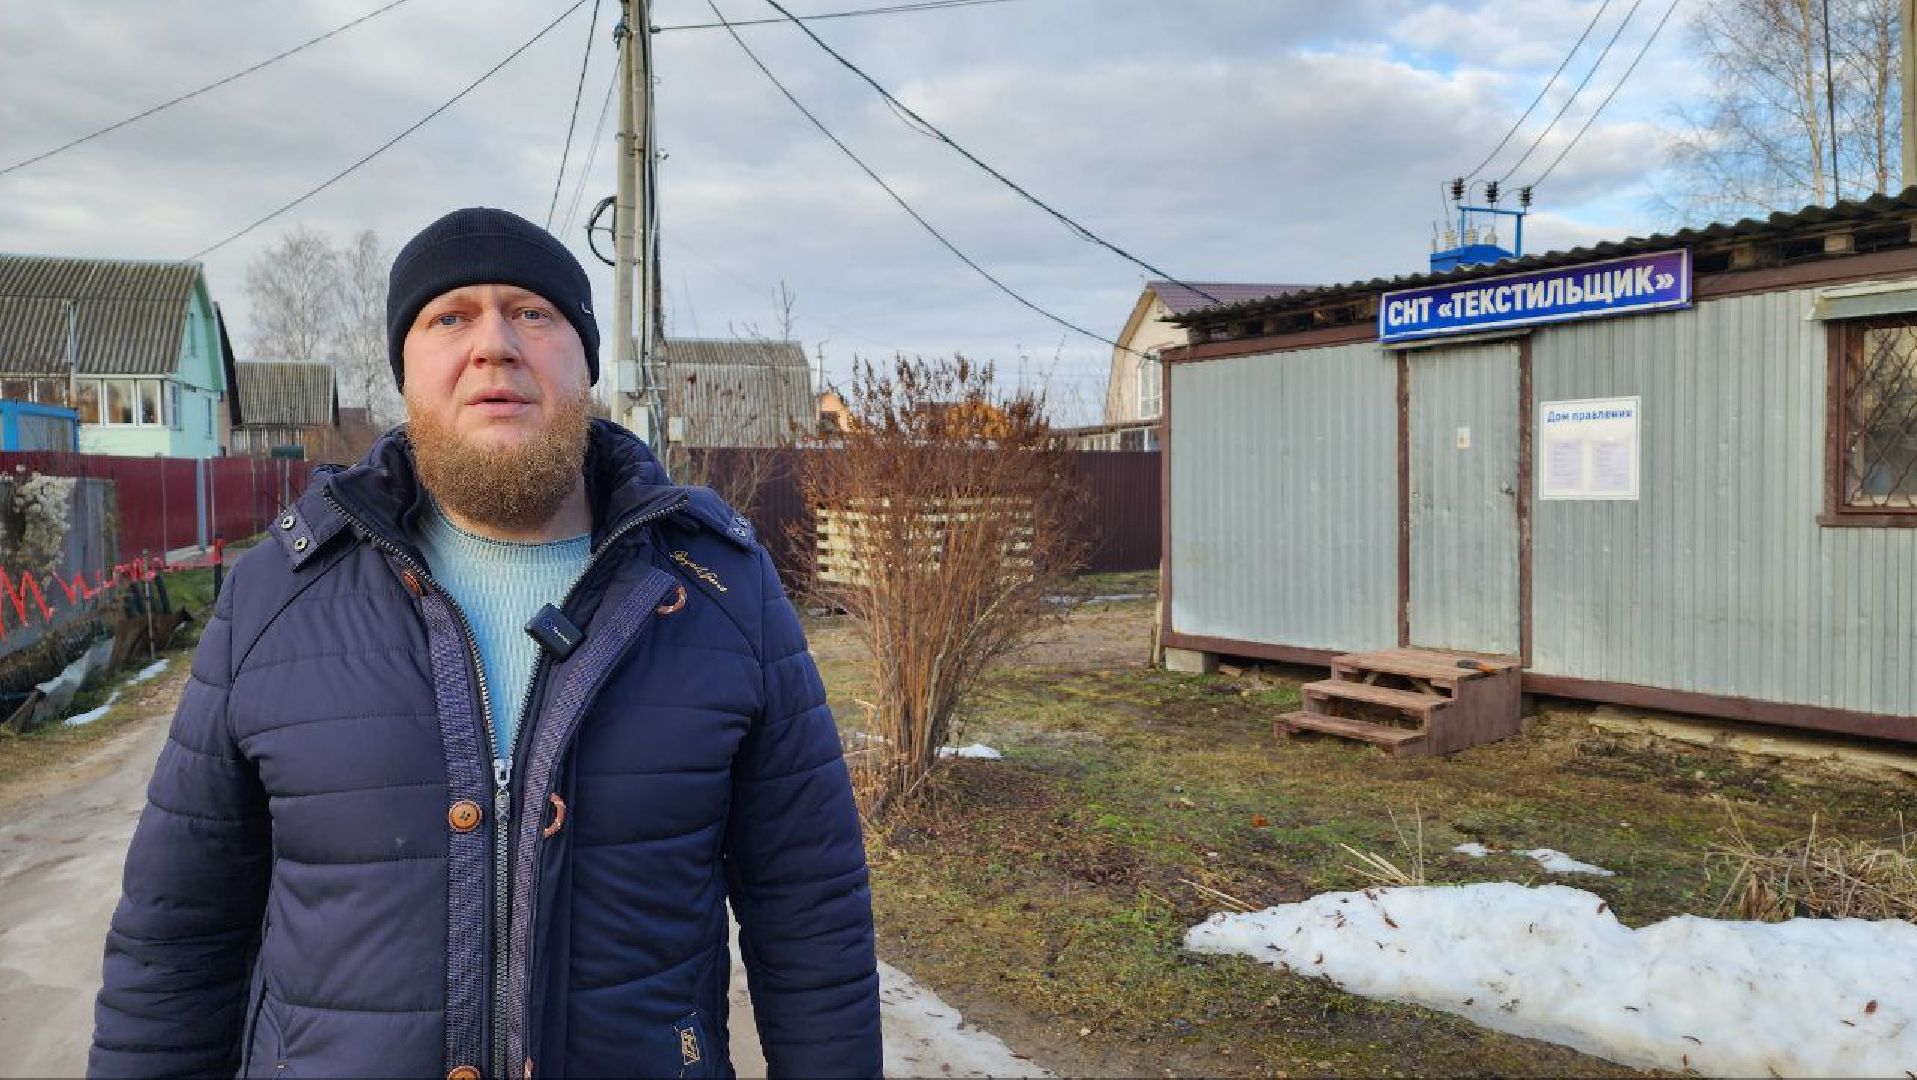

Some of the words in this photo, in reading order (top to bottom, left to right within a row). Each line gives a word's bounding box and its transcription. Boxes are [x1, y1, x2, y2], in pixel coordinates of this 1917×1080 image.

[1388, 297, 1433, 326] СНТ
[1438, 265, 1675, 318] «ТЕКСТИЛЬЩИК»
[1547, 410, 1569, 423] Дом
[1572, 409, 1632, 422] правления
